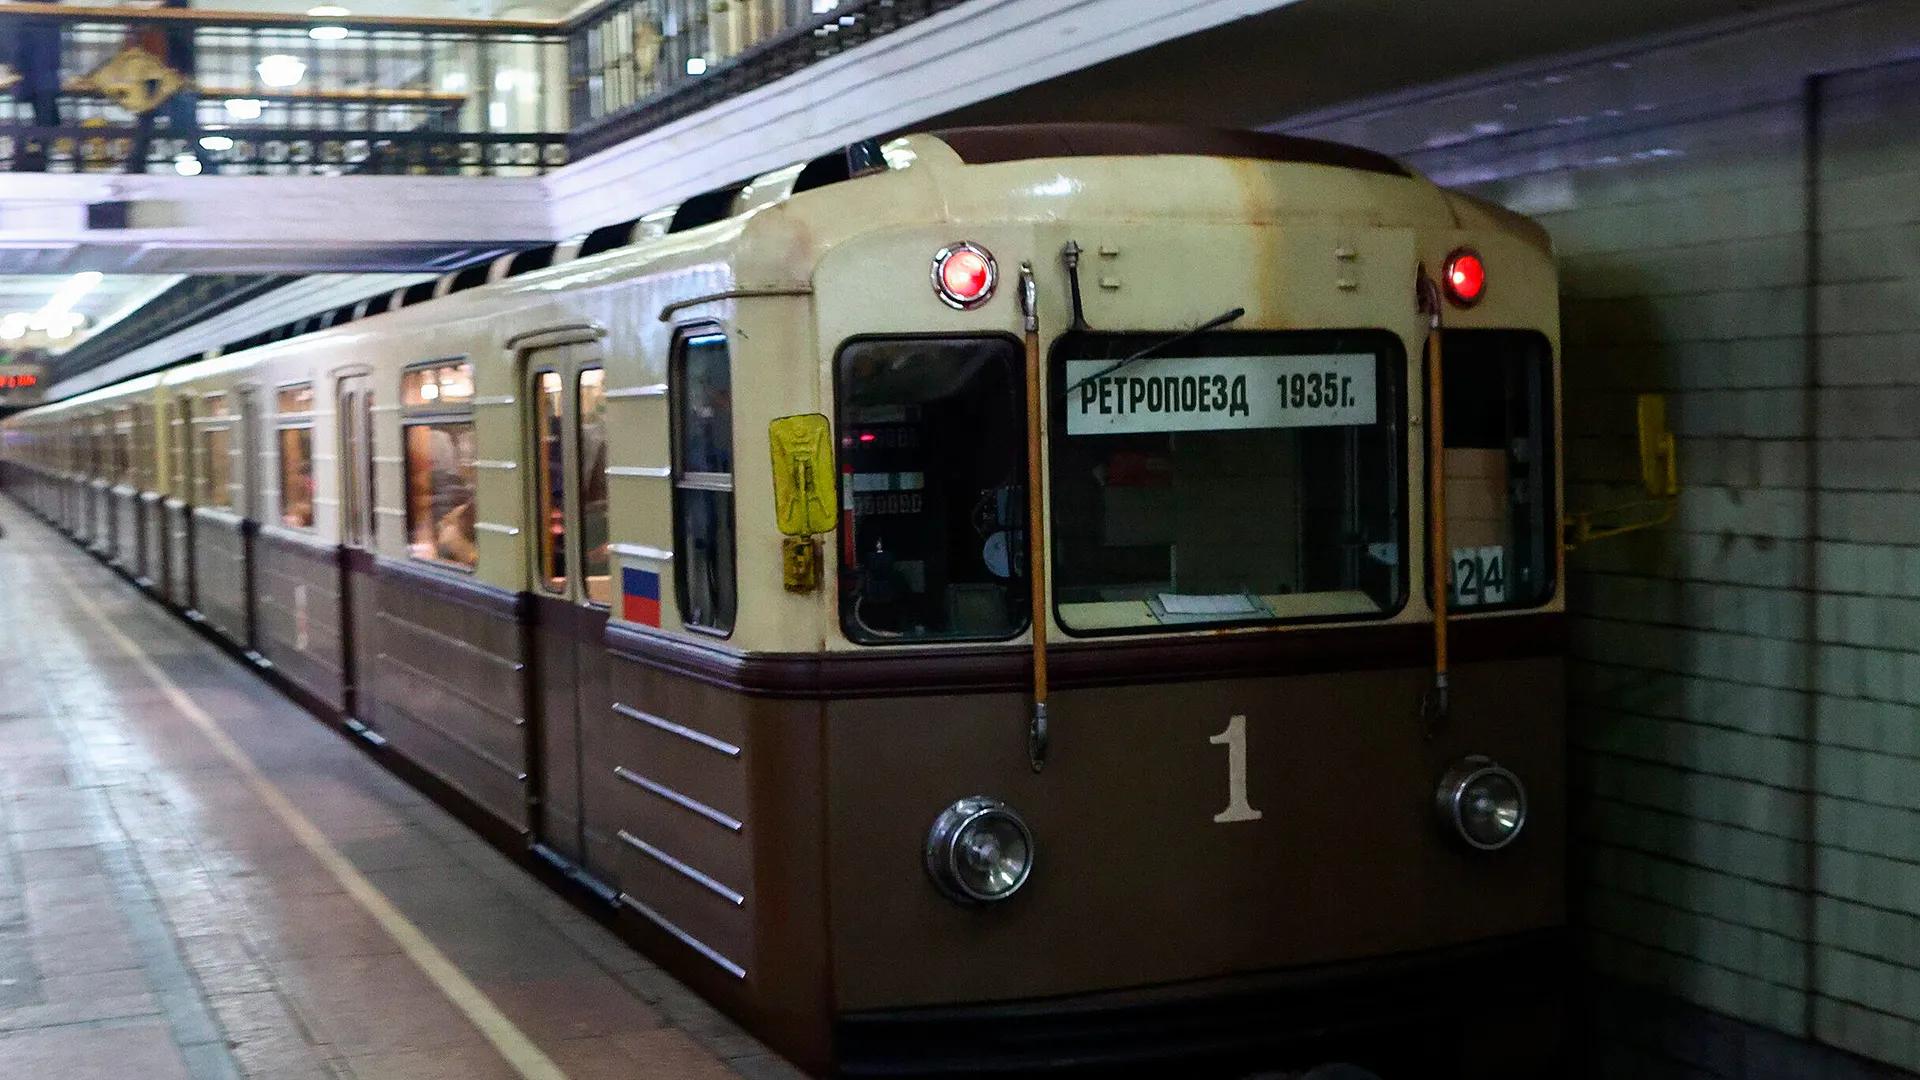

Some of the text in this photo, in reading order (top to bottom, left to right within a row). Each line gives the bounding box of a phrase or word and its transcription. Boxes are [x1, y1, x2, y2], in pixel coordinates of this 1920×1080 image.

[1080, 373, 1355, 418] РЕТРОПОЕЗД 1935г.
[1209, 714, 1263, 823] 1
